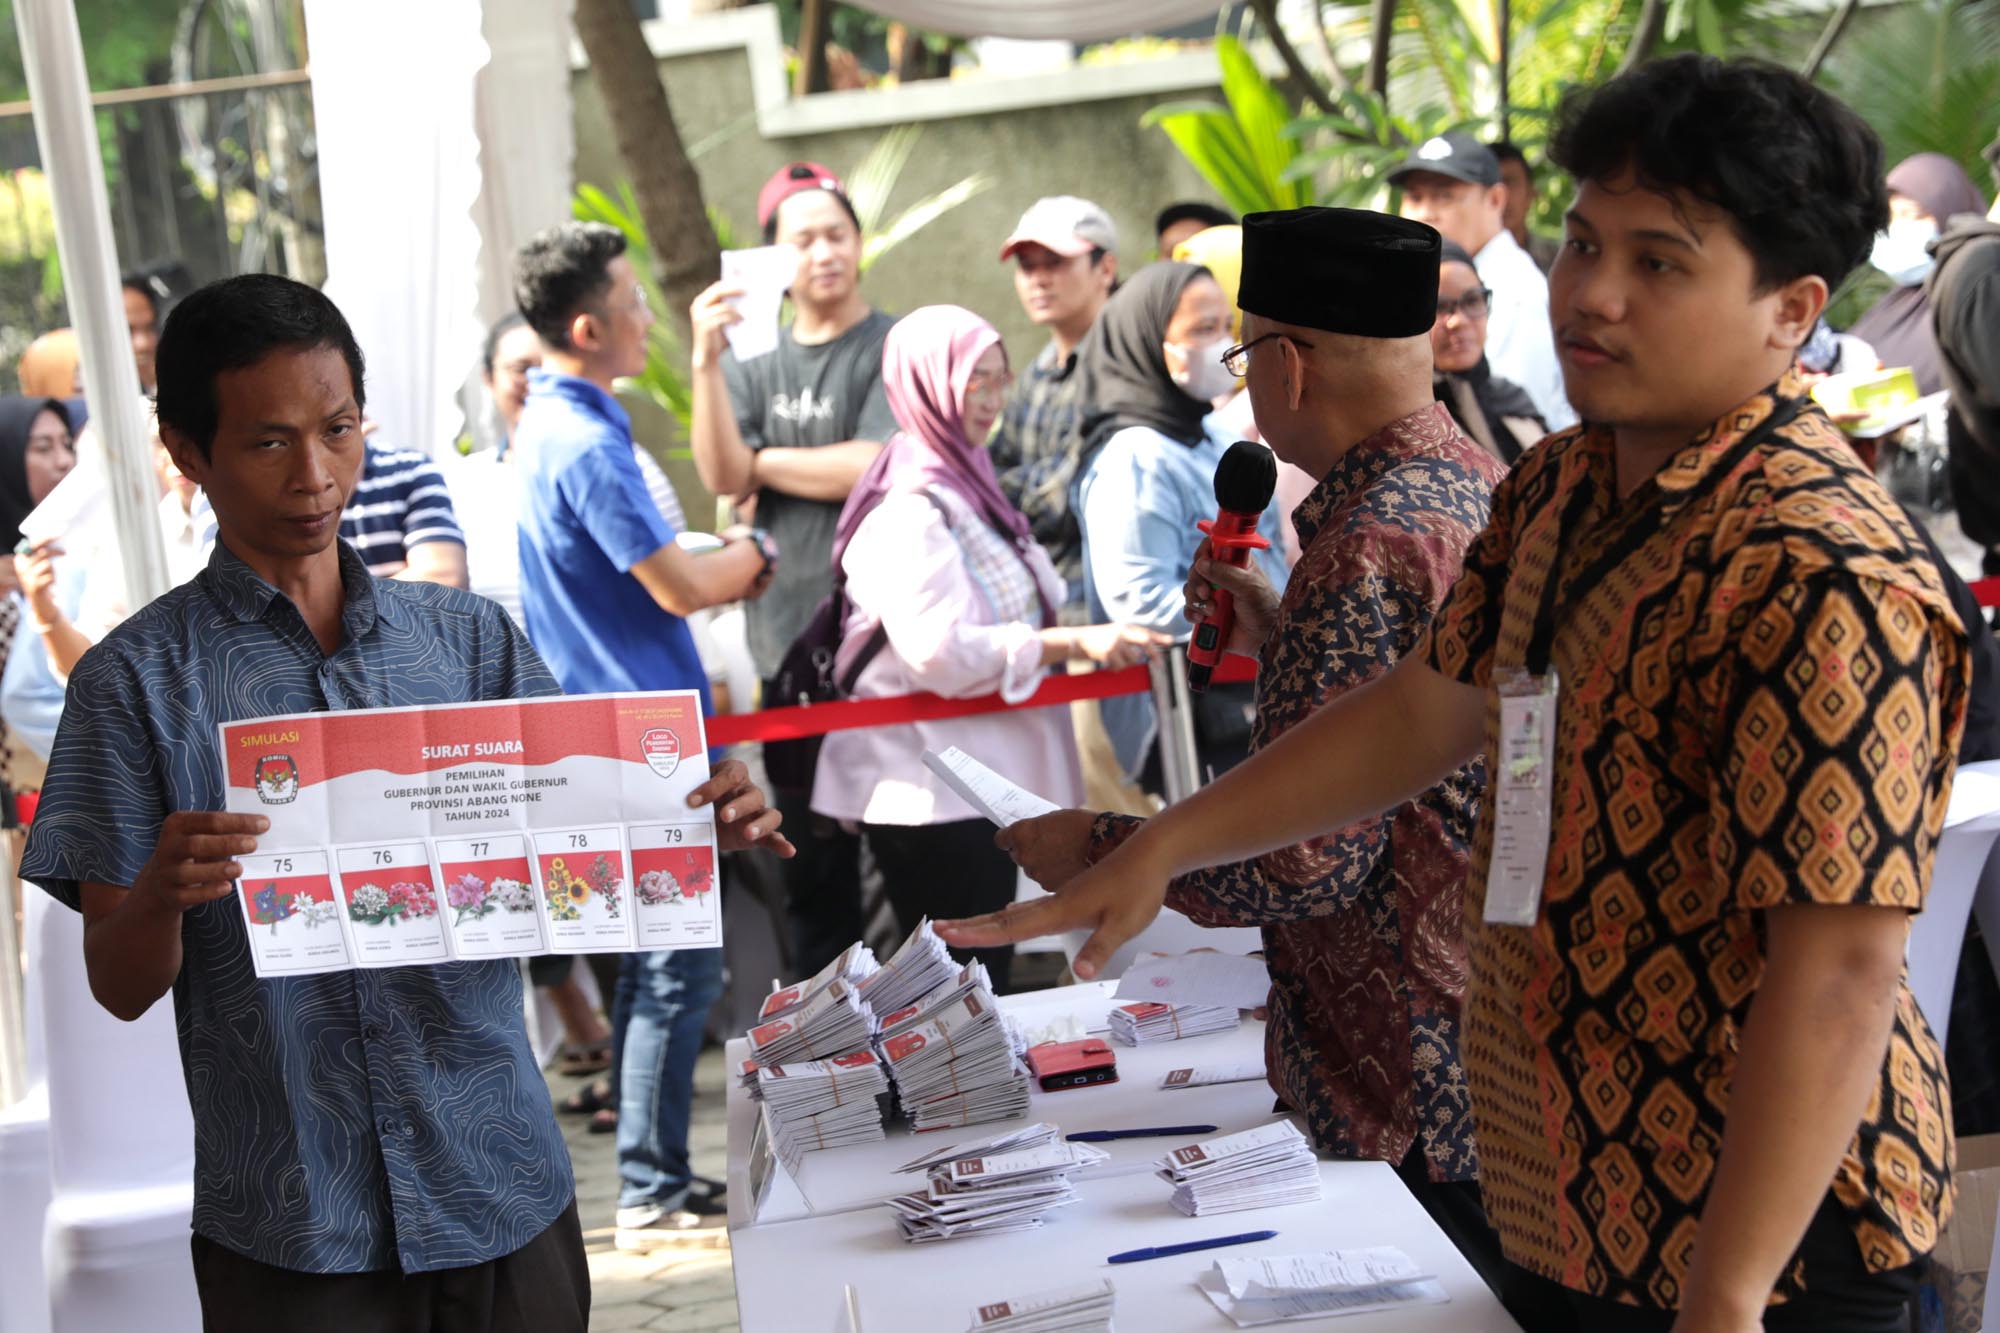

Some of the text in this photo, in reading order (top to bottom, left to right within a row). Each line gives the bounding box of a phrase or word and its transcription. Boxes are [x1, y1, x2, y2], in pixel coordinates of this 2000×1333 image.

[241, 731, 299, 747] SIMULASI
[421, 740, 524, 760] SURAT SUARA
[445, 769, 505, 781] PEMILIHAN
[384, 777, 568, 799] GUBERNUR DAN WAKIL GUBERNUR
[410, 792, 542, 811] PROVINSI ABANG NONE
[445, 808, 510, 822] TAHUN 2024
[569, 833, 588, 848] 78
[664, 829, 682, 843] 79
[471, 842, 489, 857] 77
[373, 850, 392, 865] 76
[274, 858, 293, 873] 75
